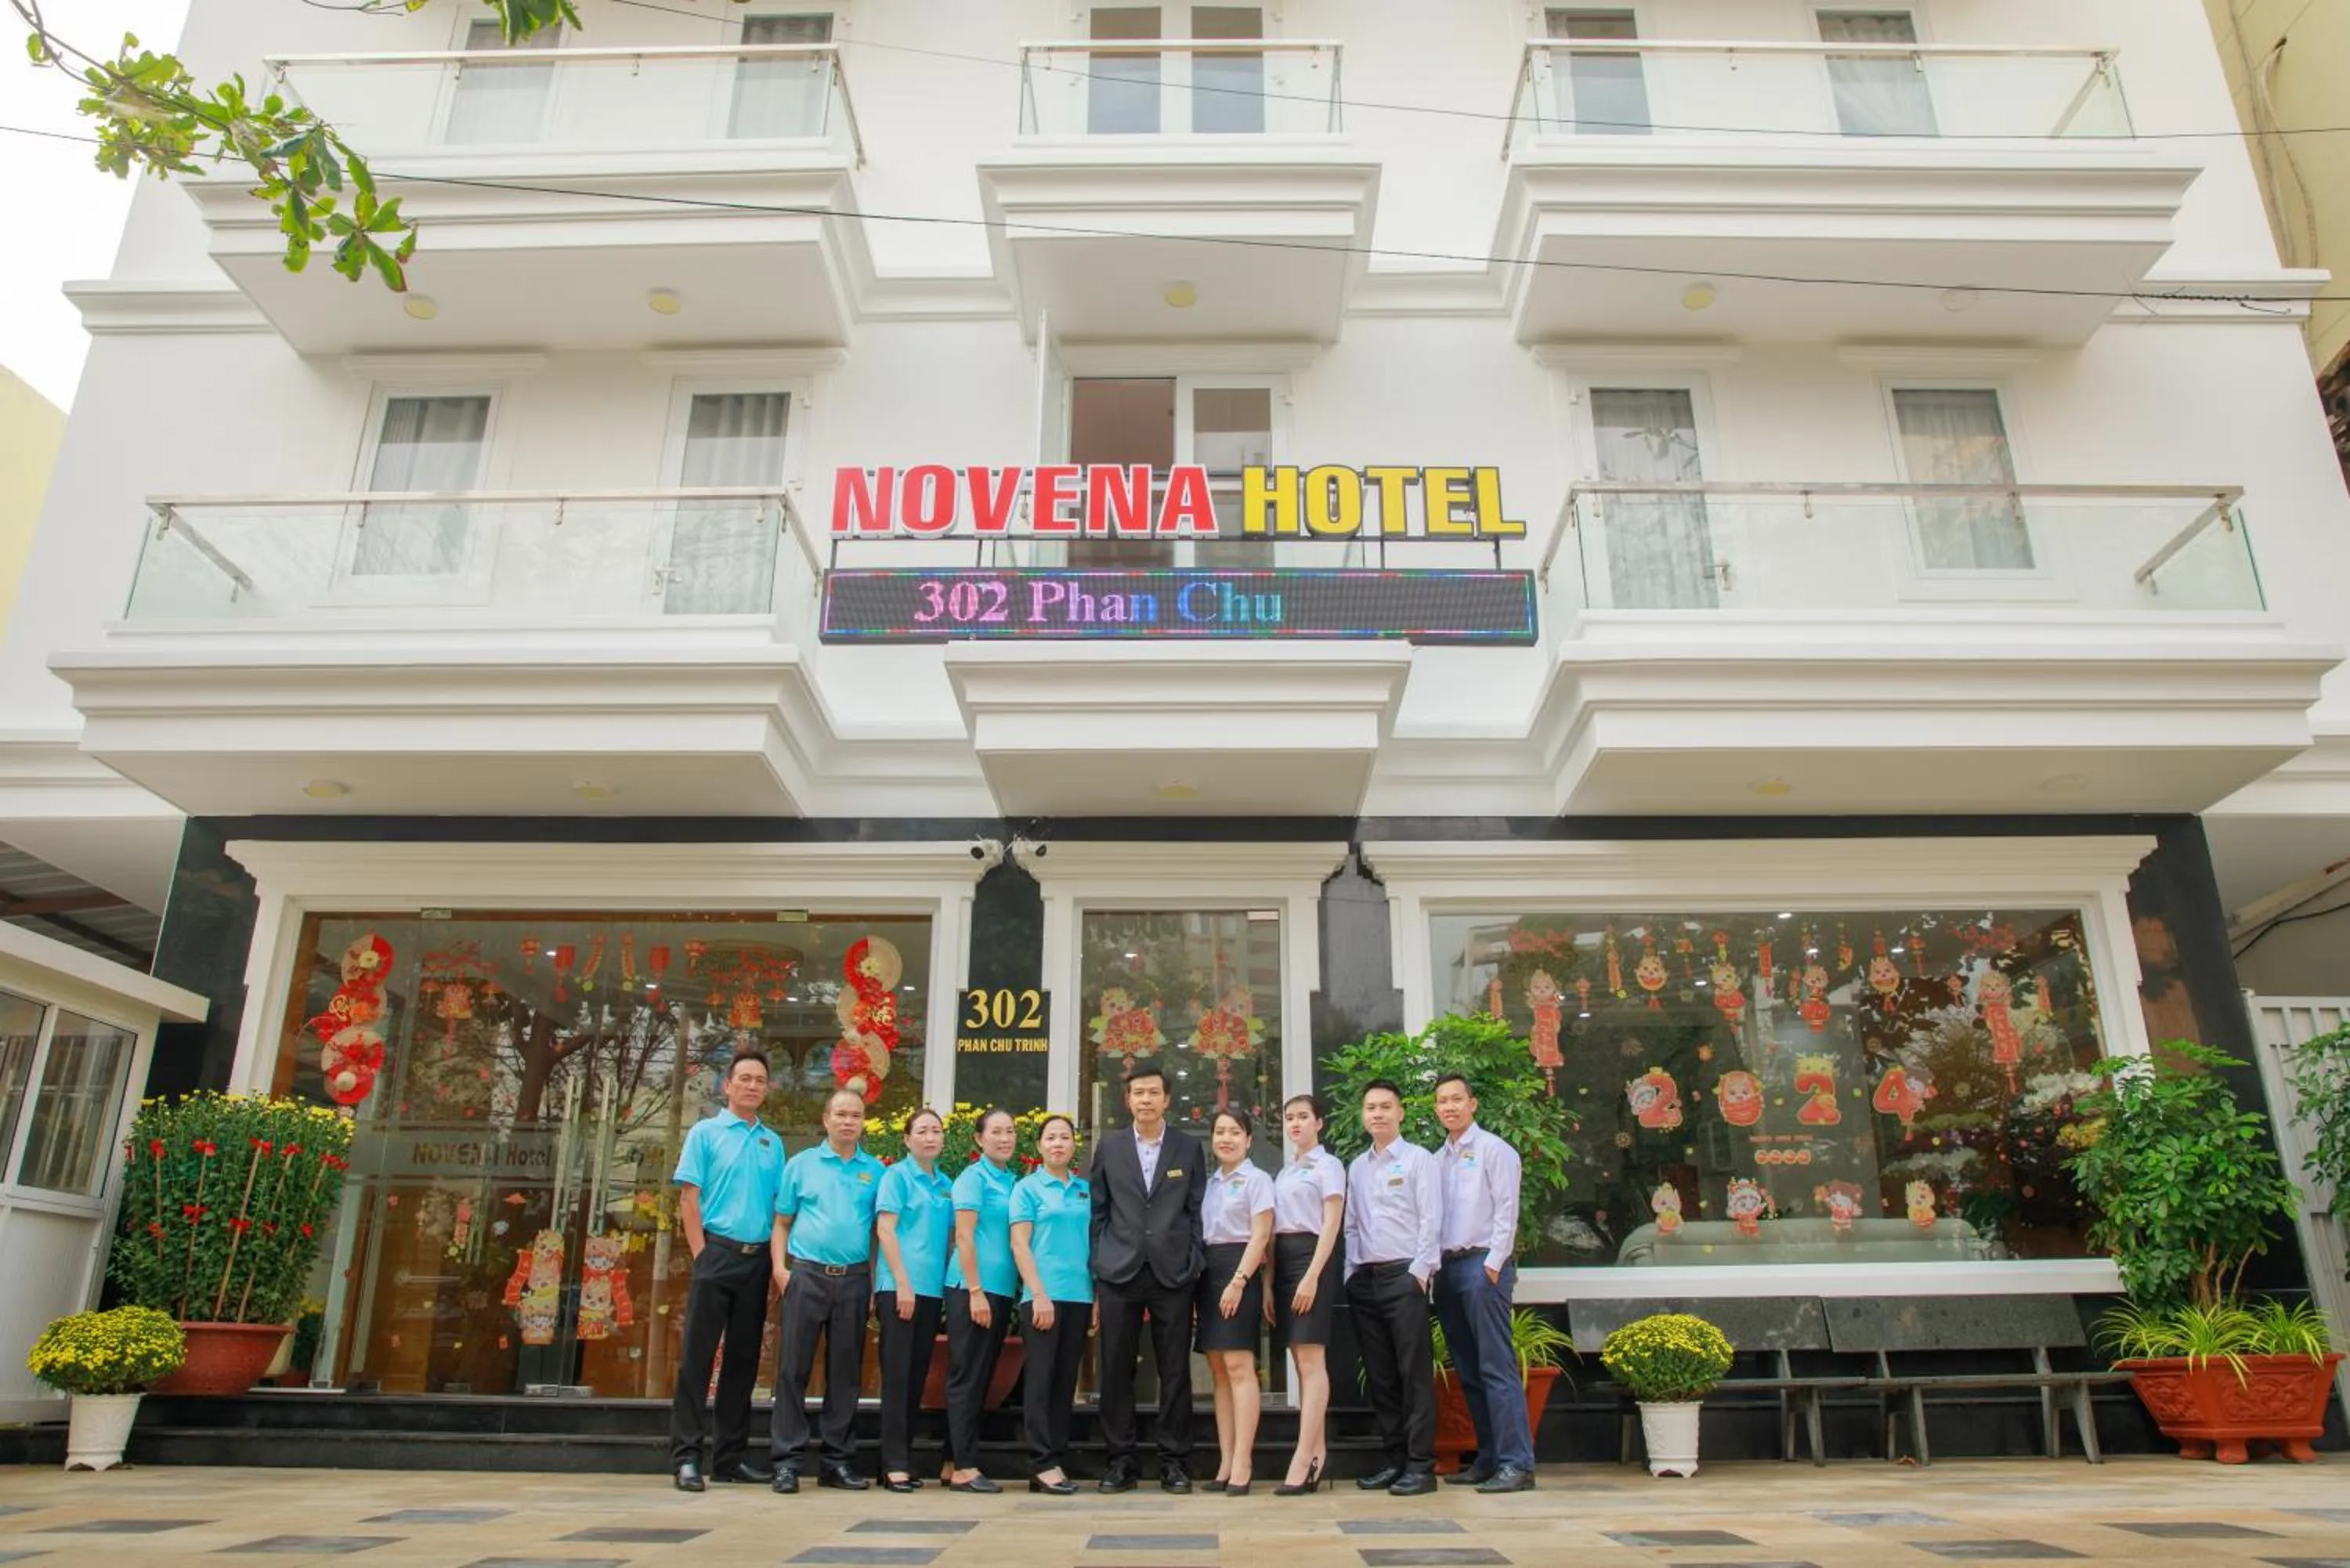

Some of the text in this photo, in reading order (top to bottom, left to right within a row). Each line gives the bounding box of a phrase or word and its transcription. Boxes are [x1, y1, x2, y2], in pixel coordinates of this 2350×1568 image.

[832, 465, 1527, 542] NOVENA HOTEL
[914, 581, 1283, 621] 302 Phan Chu
[965, 988, 1043, 1029] 302
[957, 1039, 1048, 1053] PHAN CHU TRINH
